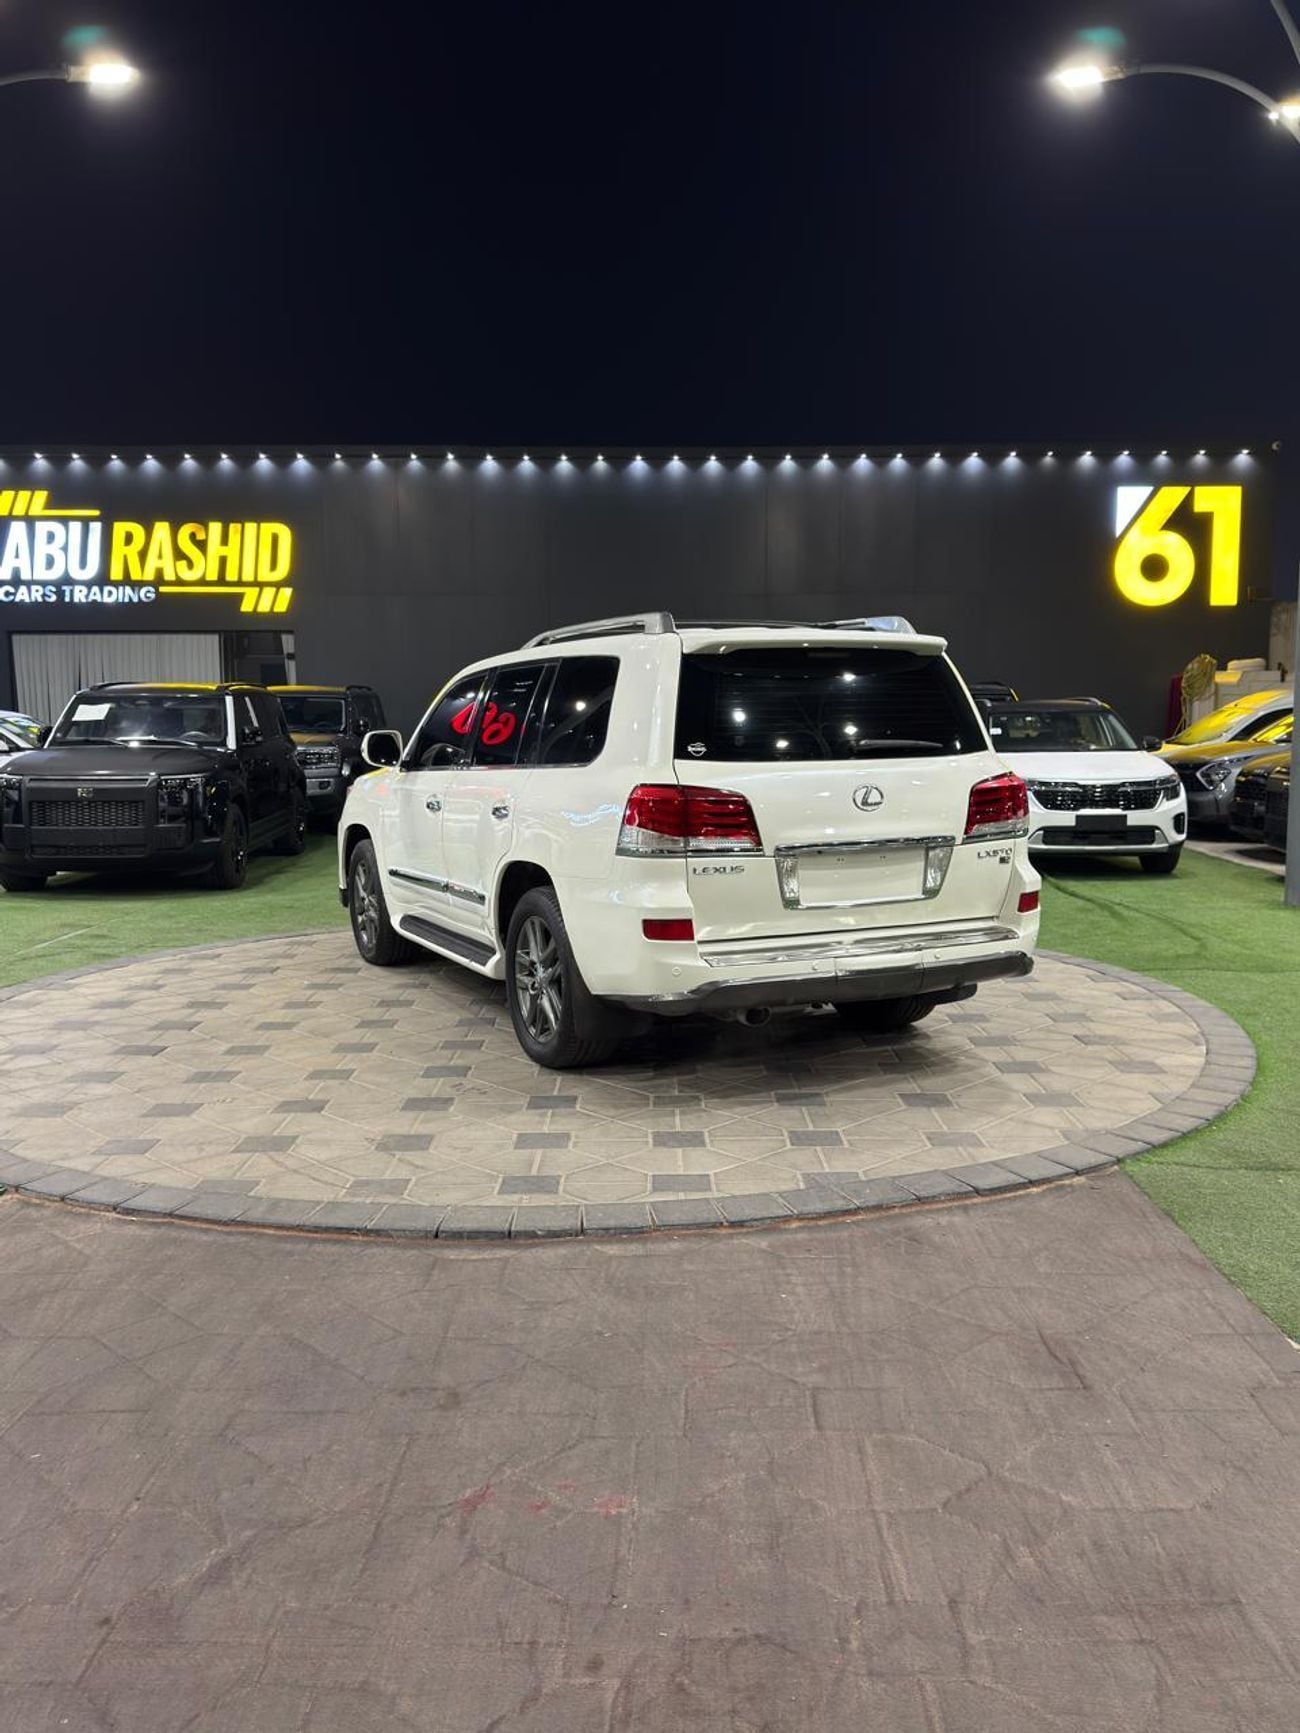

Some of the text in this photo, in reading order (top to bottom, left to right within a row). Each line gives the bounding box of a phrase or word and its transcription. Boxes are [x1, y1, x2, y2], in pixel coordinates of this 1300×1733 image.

[0, 521, 292, 582] ABU RASHID
[1114, 486, 1243, 607] 61
[0, 586, 156, 603] CARS TRADING
[692, 865, 746, 876] LEXUS
